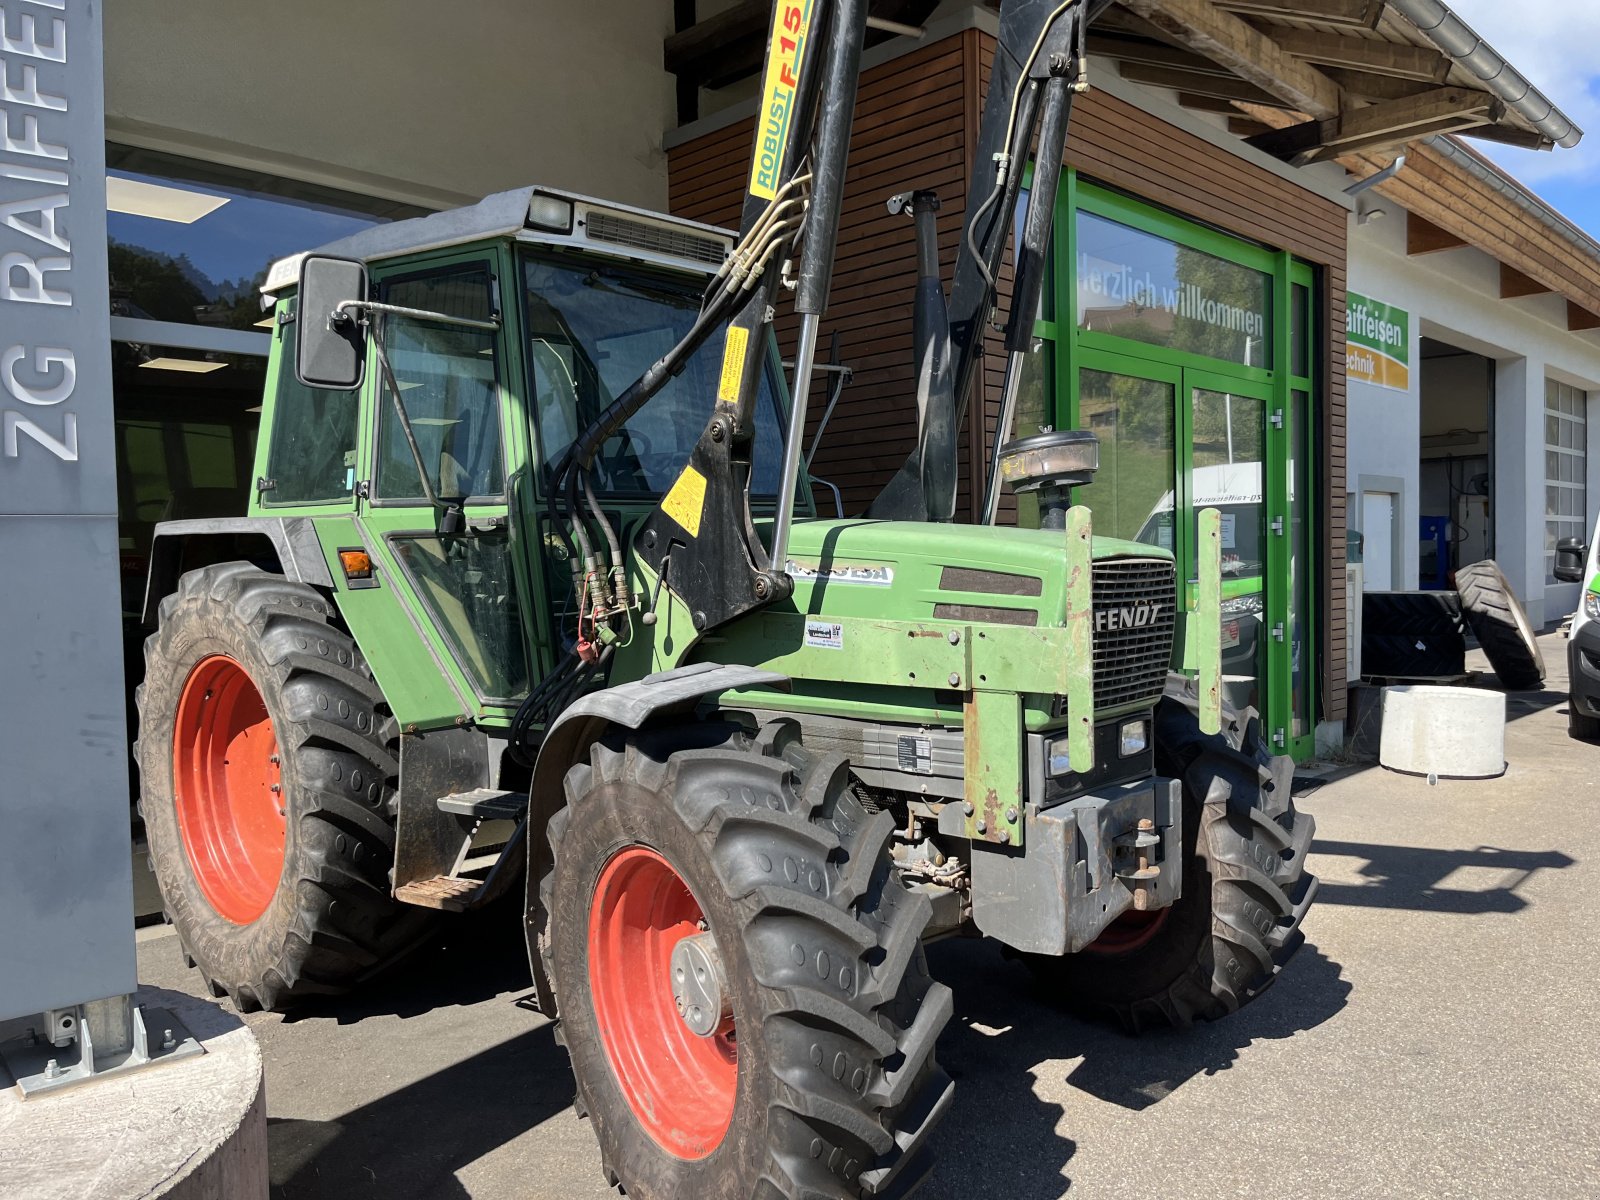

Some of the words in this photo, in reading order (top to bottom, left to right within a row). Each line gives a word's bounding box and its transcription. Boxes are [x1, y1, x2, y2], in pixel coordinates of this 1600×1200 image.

[757, 86, 787, 189] ROBUST
[1162, 282, 1264, 338] willkommen
[2, 343, 78, 462] ZG
[1095, 604, 1163, 632] FENDT
